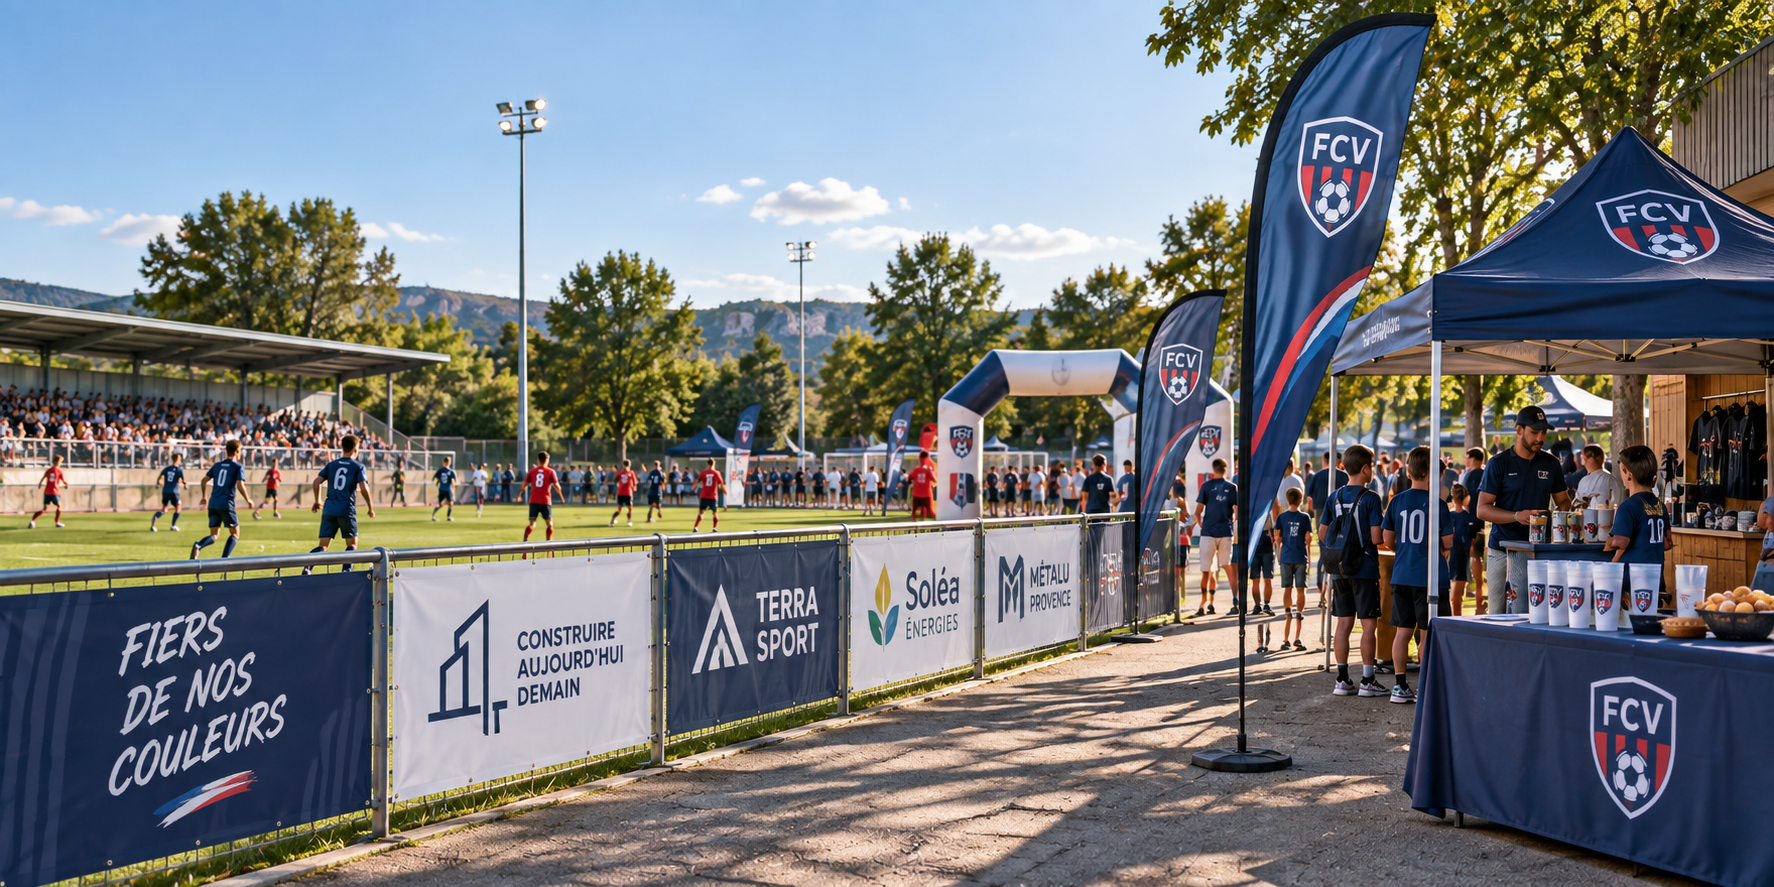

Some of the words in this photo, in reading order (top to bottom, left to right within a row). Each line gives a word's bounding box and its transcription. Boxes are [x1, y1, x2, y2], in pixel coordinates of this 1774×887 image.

[1311, 132, 1372, 166] FCV
[1615, 202, 1691, 224] FCV
[1166, 351, 1197, 369] FCV
[333, 466, 348, 491] 6
[535, 474, 545, 488] 8
[1399, 508, 1426, 544] 10
[905, 566, 960, 611] Soléa
[1030, 558, 1070, 588] MÉTALU
[756, 585, 819, 623] TERRA
[1030, 589, 1072, 613] PROVENCE
[118, 606, 227, 677] FIERS
[517, 620, 616, 652] CONSTRUIRE
[756, 621, 819, 663] SPORT
[905, 612, 959, 640] ÉNERGIES
[517, 644, 624, 679] AUJOURD'HUI
[119, 676, 177, 735] DE
[185, 651, 256, 713] NOS
[517, 677, 580, 706] DEMAIN
[1603, 695, 1664, 735] FCV
[108, 693, 288, 796] COULEURS
